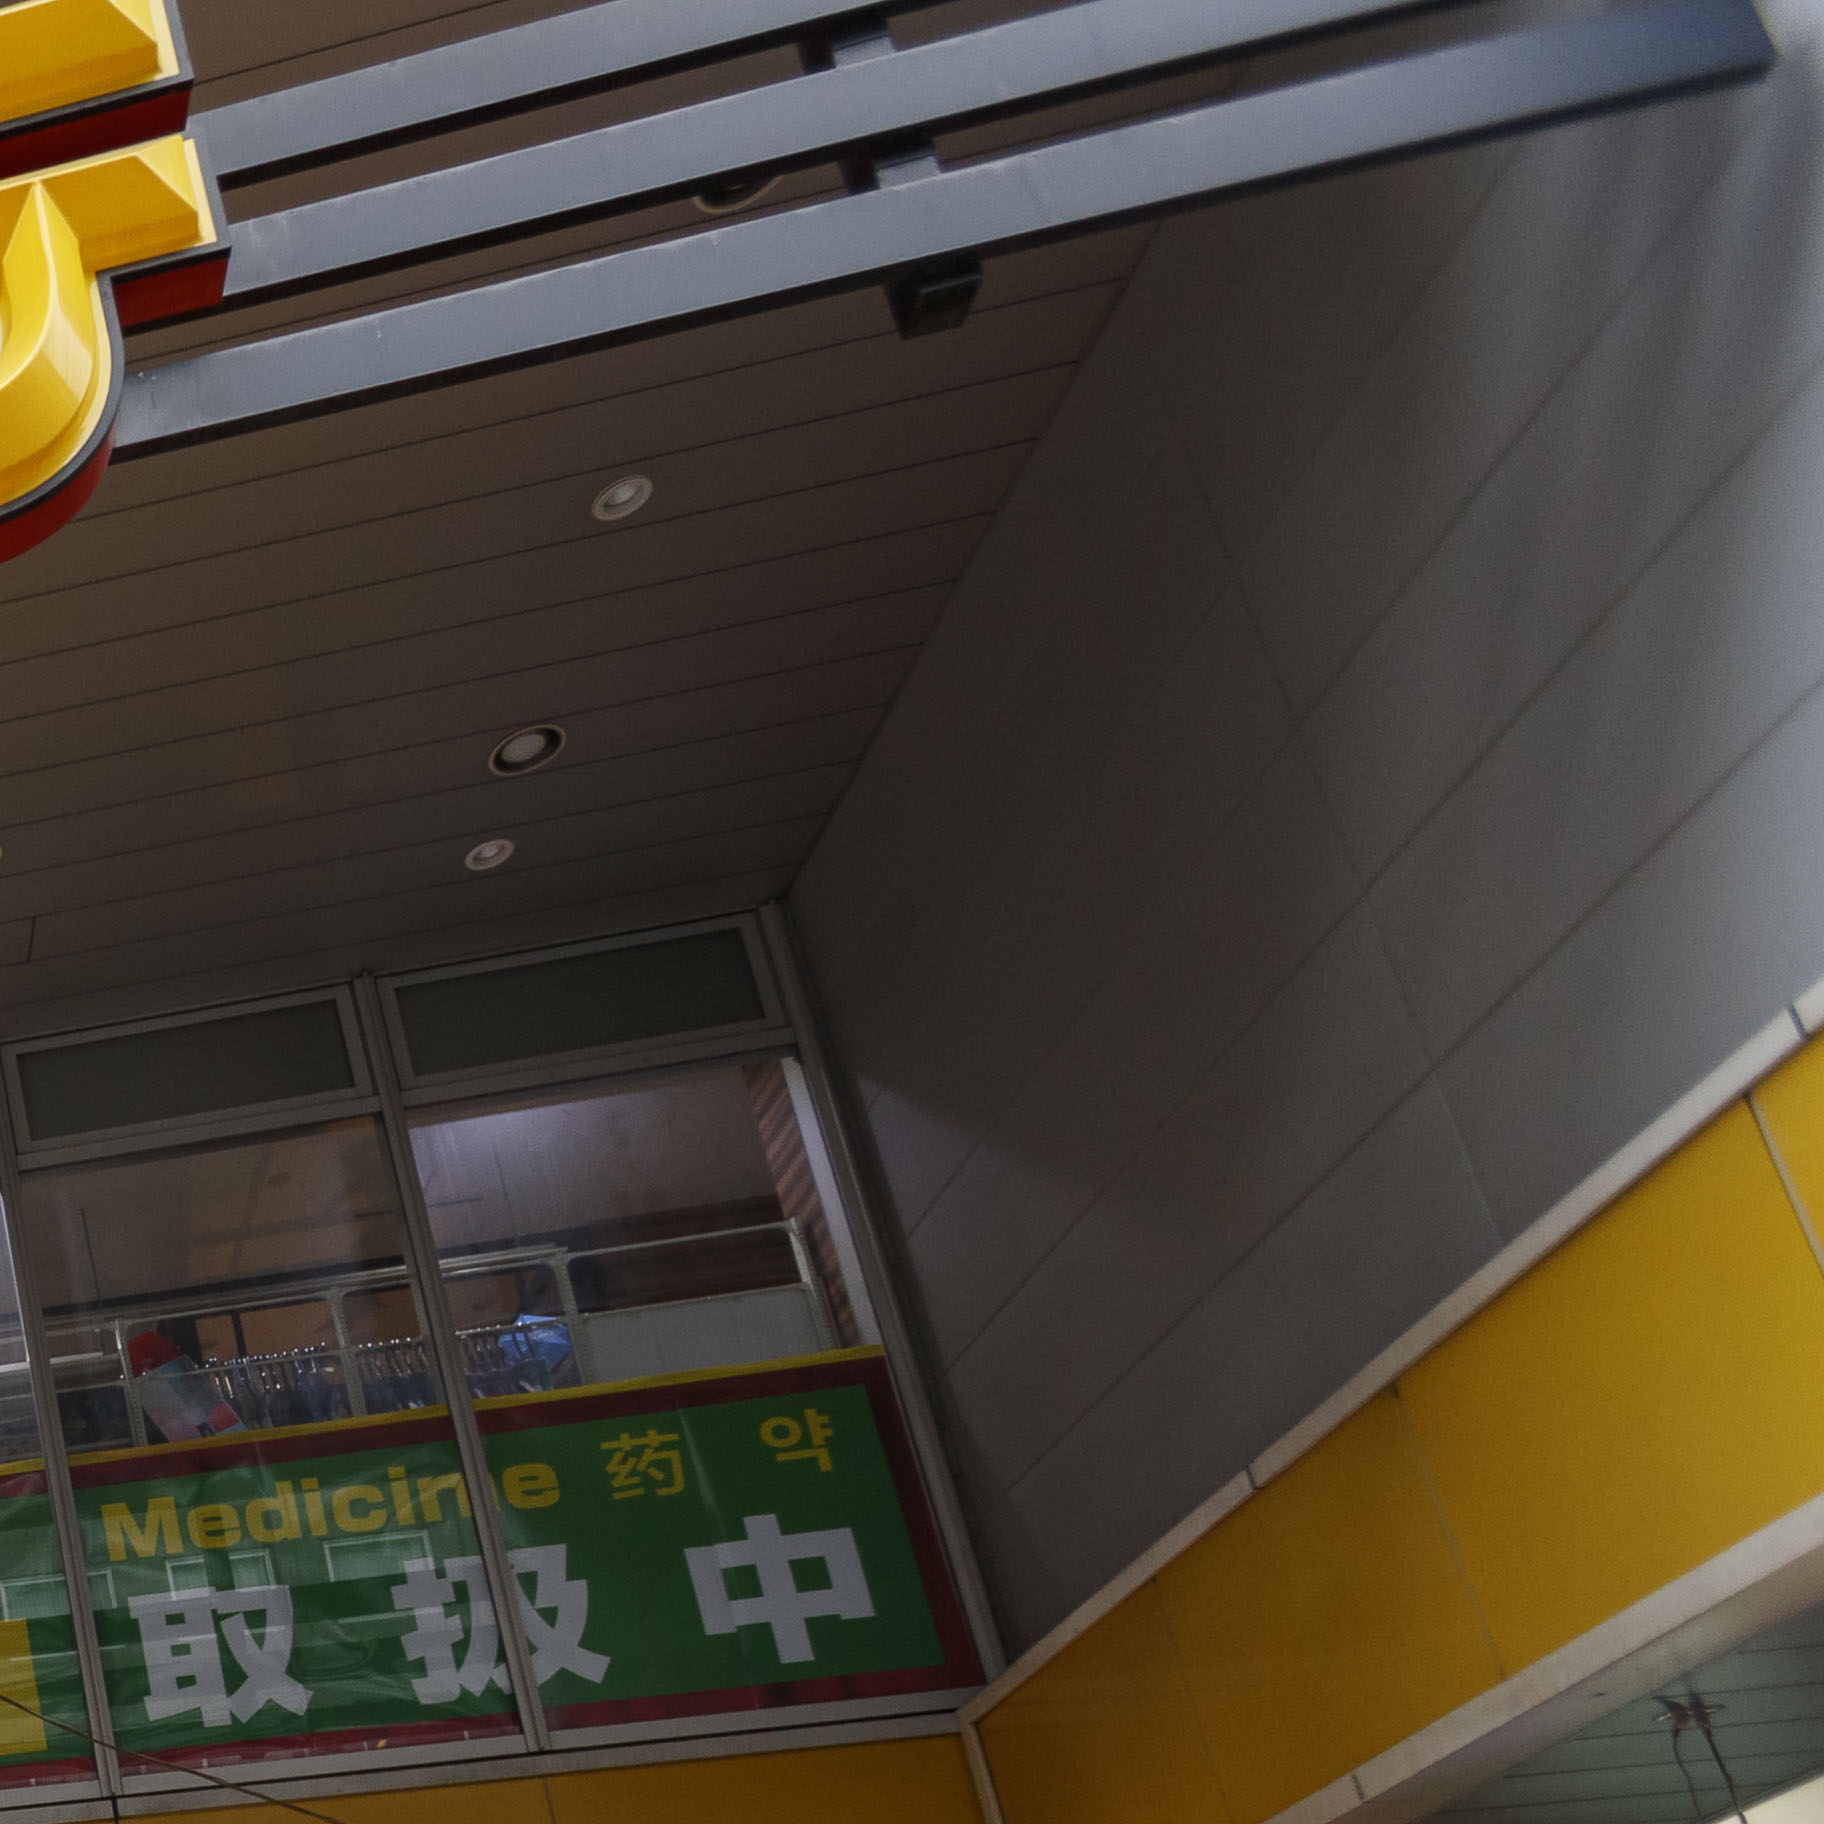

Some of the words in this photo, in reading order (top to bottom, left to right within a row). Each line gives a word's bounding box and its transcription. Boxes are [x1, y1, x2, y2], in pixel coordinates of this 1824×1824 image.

[101, 1457, 561, 1563] Medicine
[129, 1513, 875, 1728] 取扱中
